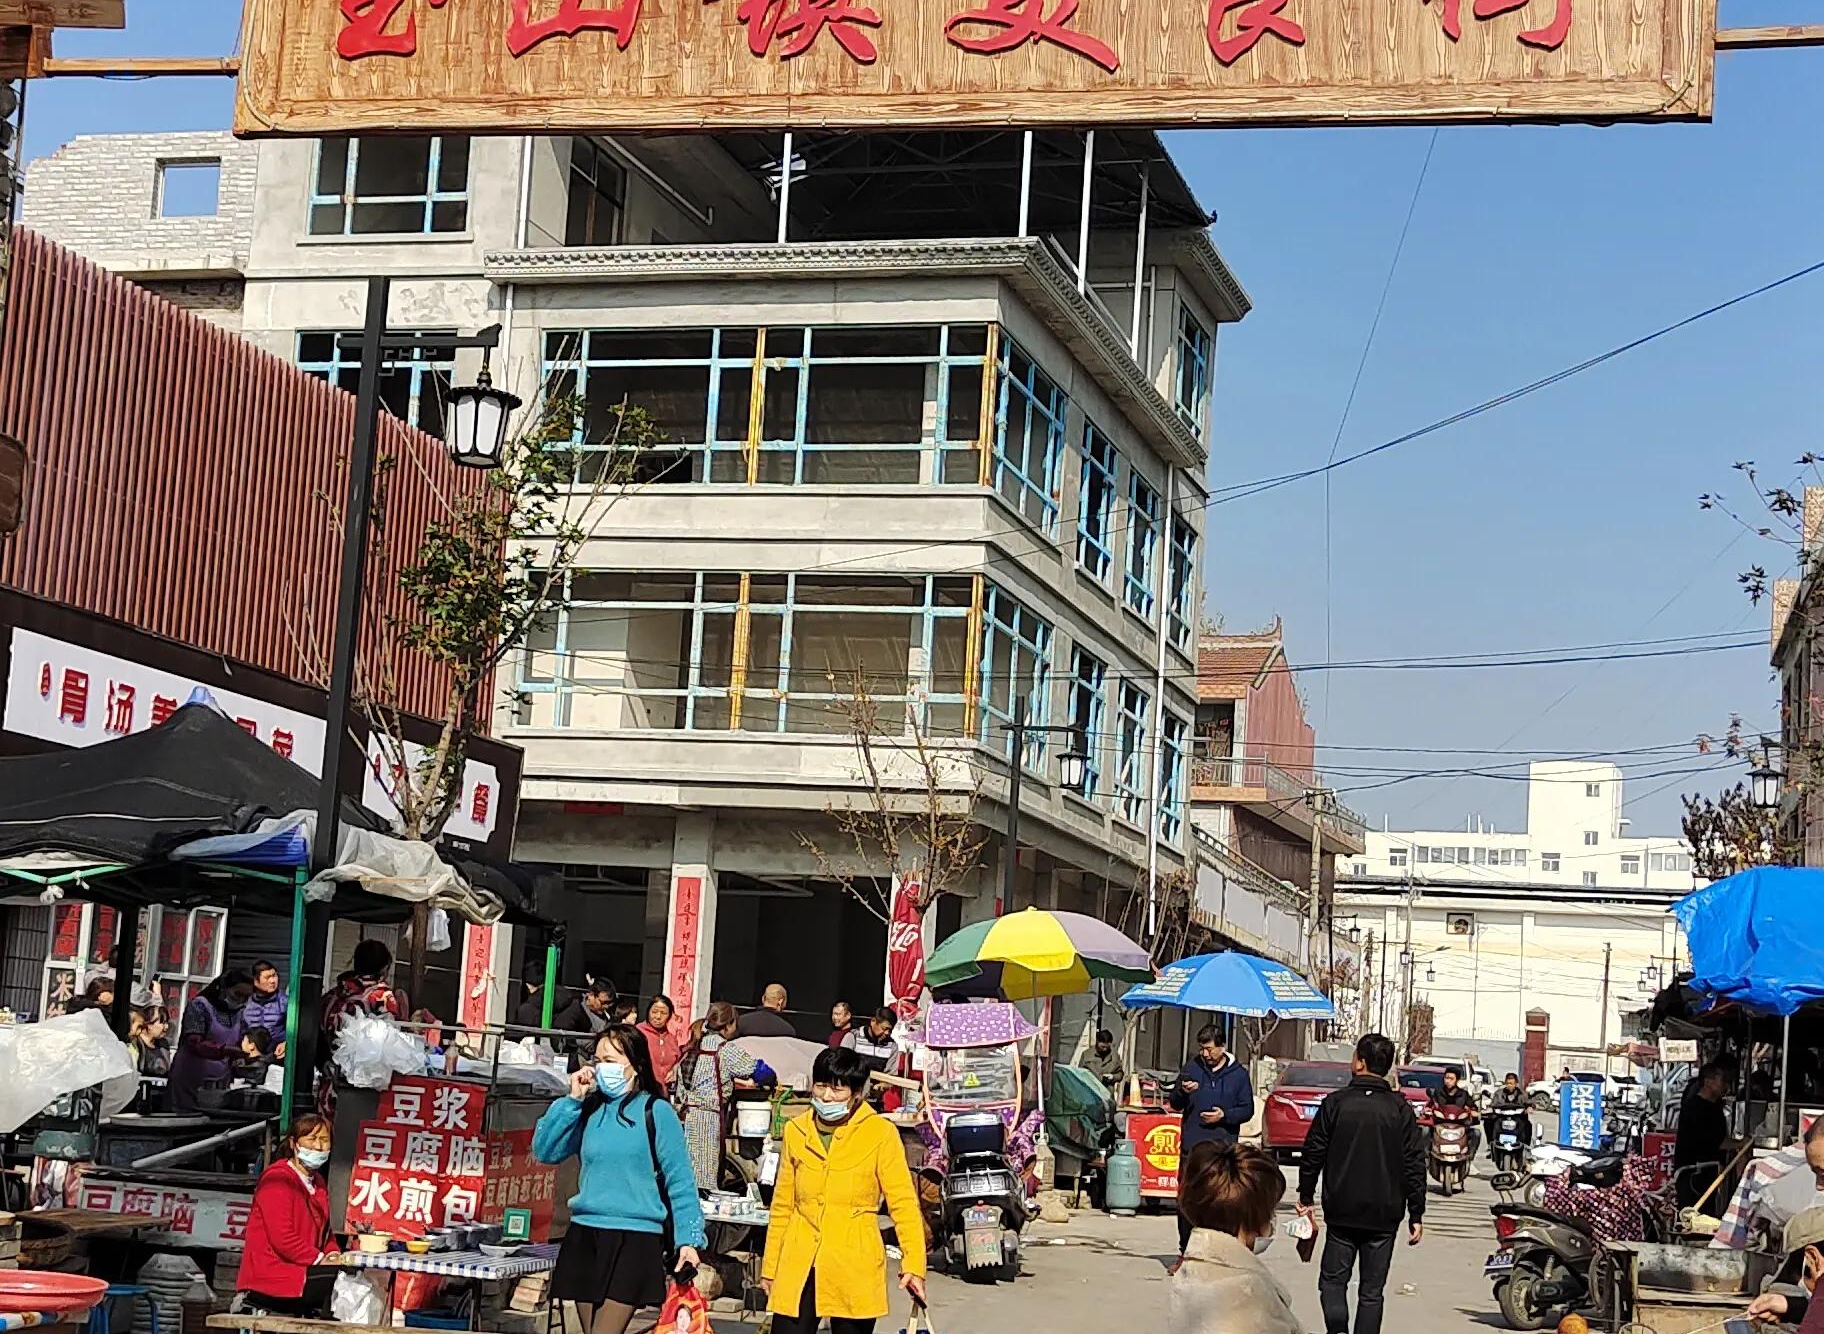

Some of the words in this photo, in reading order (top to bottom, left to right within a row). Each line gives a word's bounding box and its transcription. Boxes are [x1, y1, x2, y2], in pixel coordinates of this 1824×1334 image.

[385, 1085, 471, 1130] 豆浆
[357, 1128, 487, 1177] 豆腐脑
[350, 1171, 478, 1227] 水煎包
